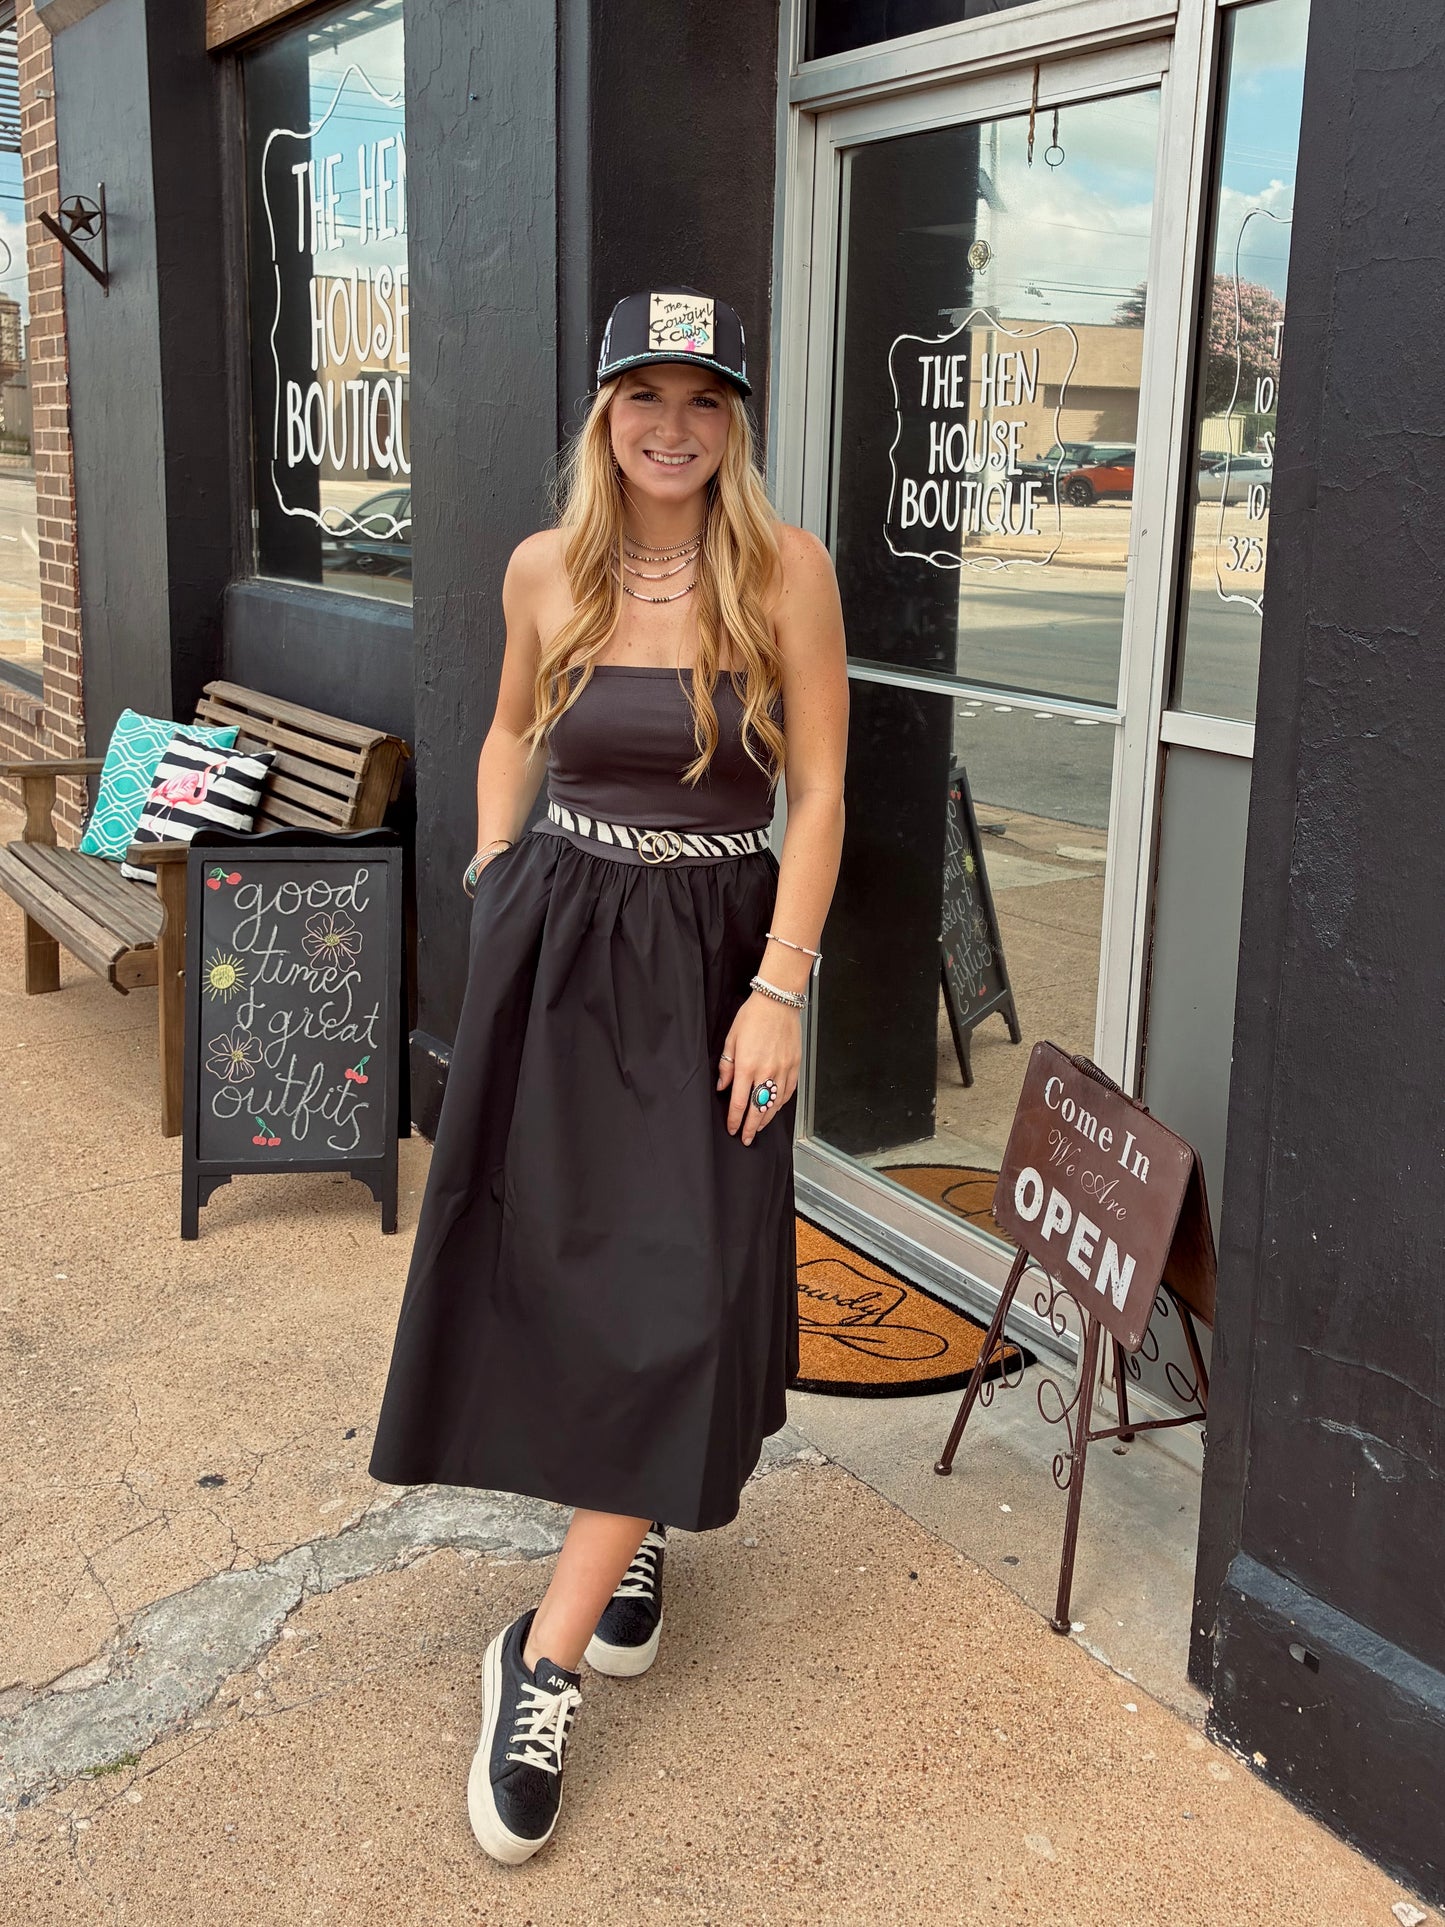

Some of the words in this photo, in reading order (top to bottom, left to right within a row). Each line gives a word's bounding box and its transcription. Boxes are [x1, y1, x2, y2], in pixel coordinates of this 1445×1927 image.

[292, 153, 344, 254] THE
[310, 265, 411, 371] HOUSE
[650, 303, 714, 333] Cowgirl
[664, 302, 682, 314] The
[669, 325, 703, 342] Club
[918, 354, 967, 409] THE
[979, 348, 1040, 408] HEN
[928, 419, 1028, 476] HOUSE
[900, 478, 1042, 536] BOUTIQUE
[232, 868, 369, 952] good
[250, 924, 362, 1027] times
[263, 1002, 379, 1069] great
[212, 1054, 370, 1150] outfits
[1044, 1076, 1114, 1153] Come
[1117, 1130, 1152, 1184] In
[1047, 1129, 1082, 1177] We
[1080, 1170, 1127, 1221] Are
[1014, 1166, 1137, 1313] OPEN
